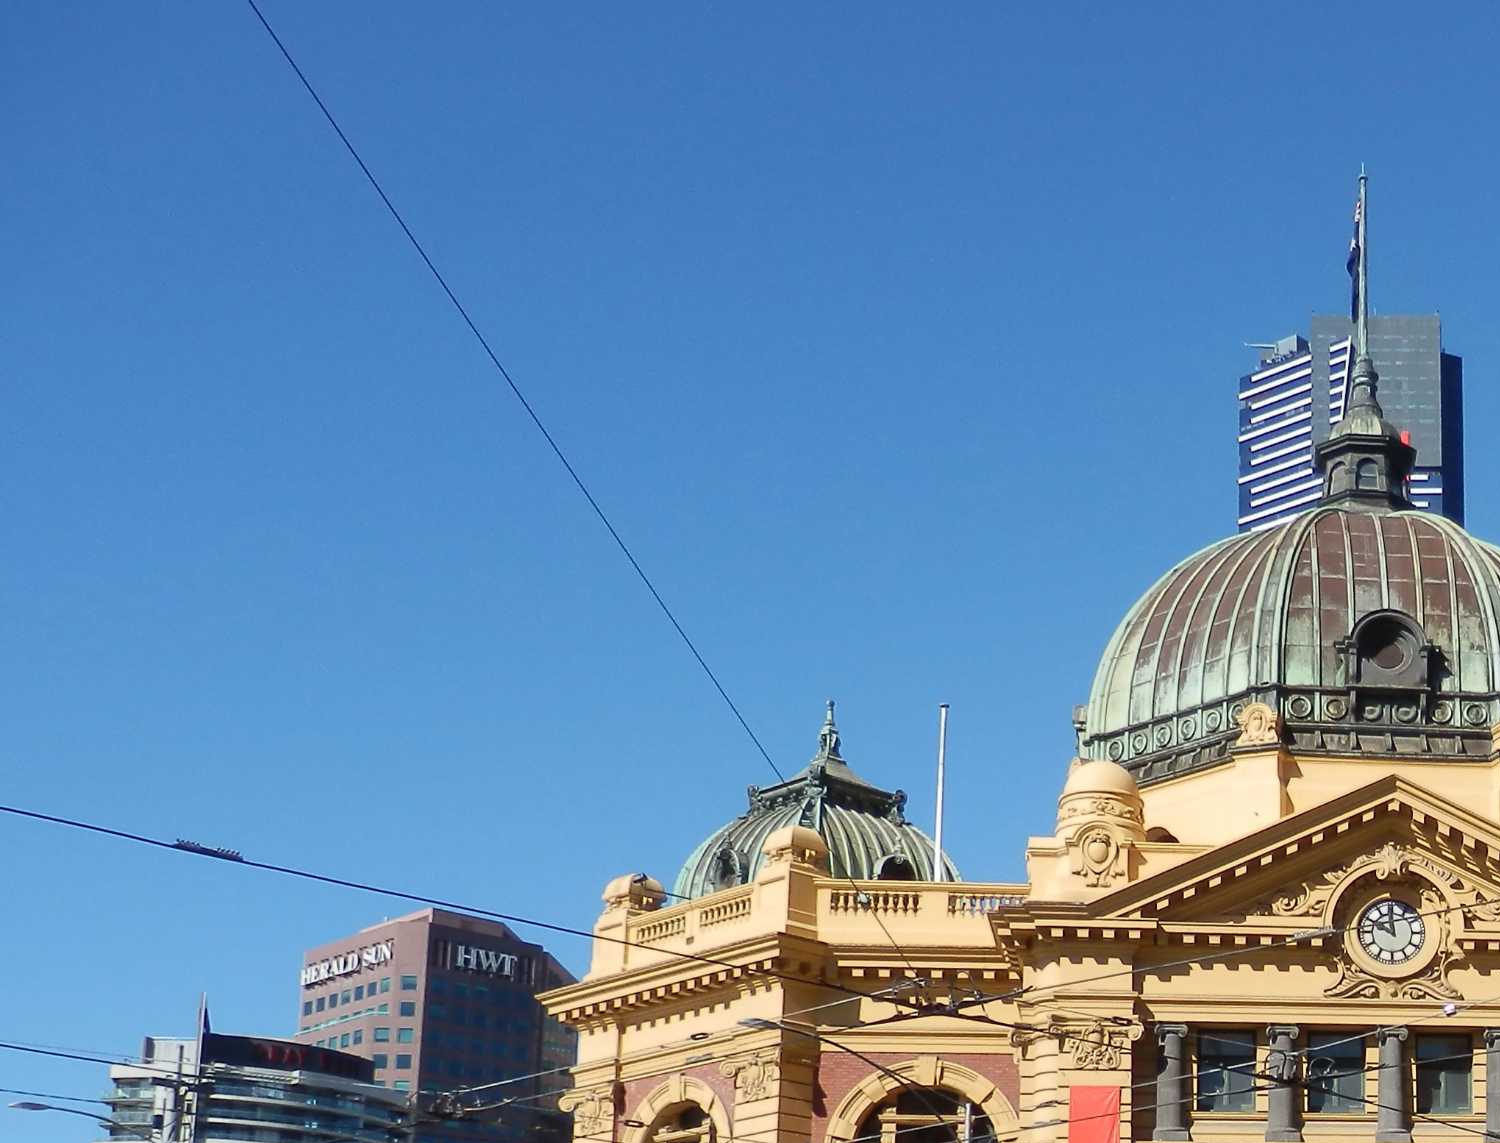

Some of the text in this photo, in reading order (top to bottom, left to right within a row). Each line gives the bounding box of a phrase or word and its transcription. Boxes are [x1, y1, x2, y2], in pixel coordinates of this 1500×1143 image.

[300, 940, 394, 987] HERALD SUN
[455, 944, 519, 978] HWT
